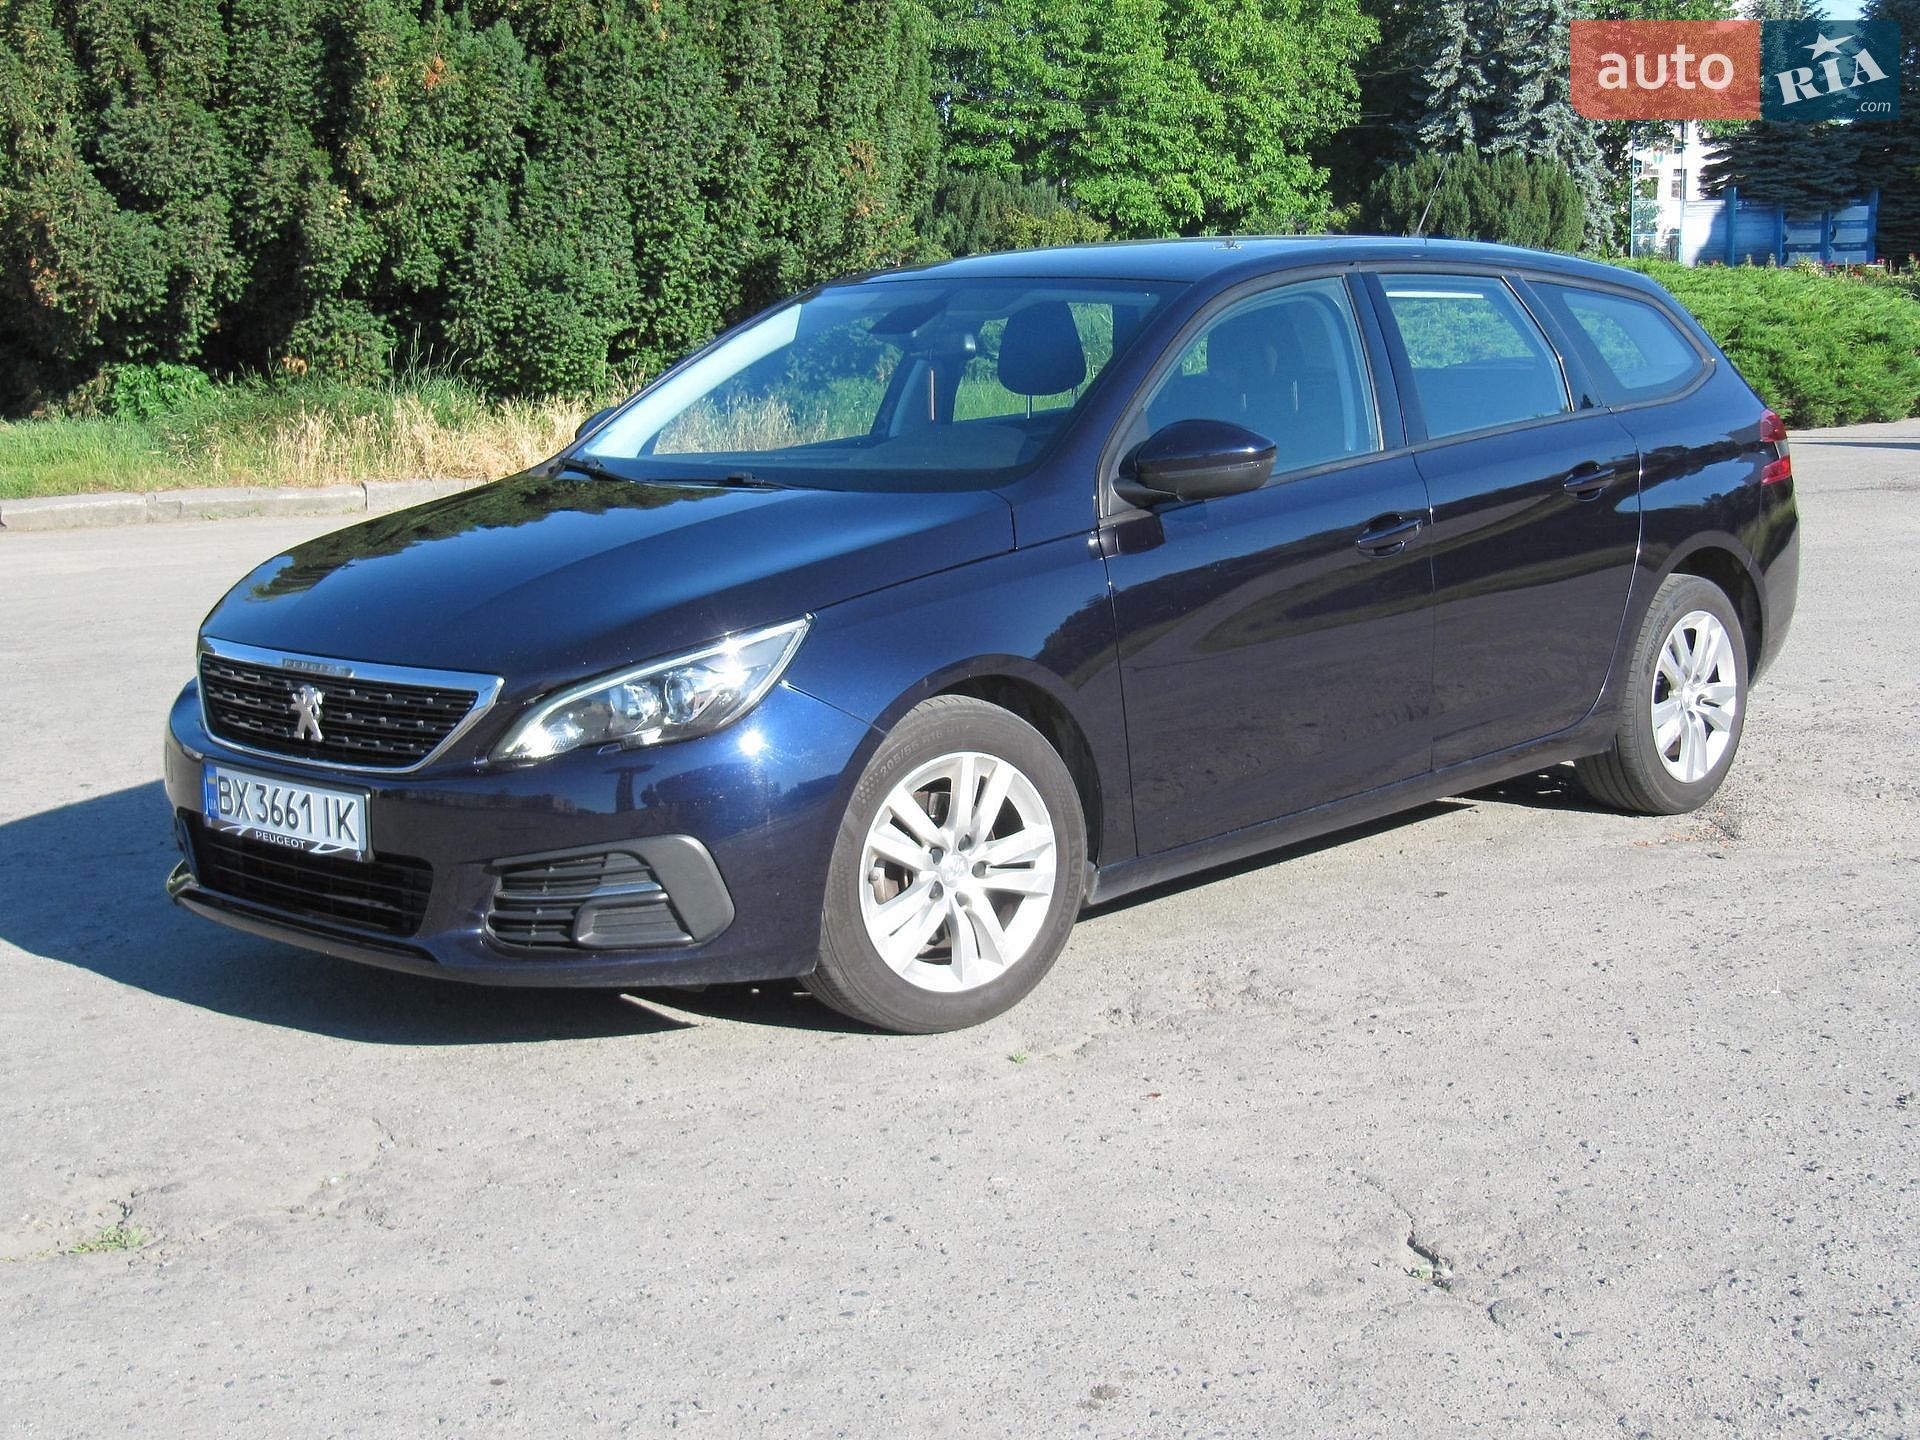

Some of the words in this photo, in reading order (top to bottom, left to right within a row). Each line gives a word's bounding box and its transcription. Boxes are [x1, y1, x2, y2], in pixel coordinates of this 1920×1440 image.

[218, 775, 252, 822] BX
[255, 783, 313, 834] 3661
[325, 794, 358, 843] IK
[255, 830, 306, 849] PEUGEOT
